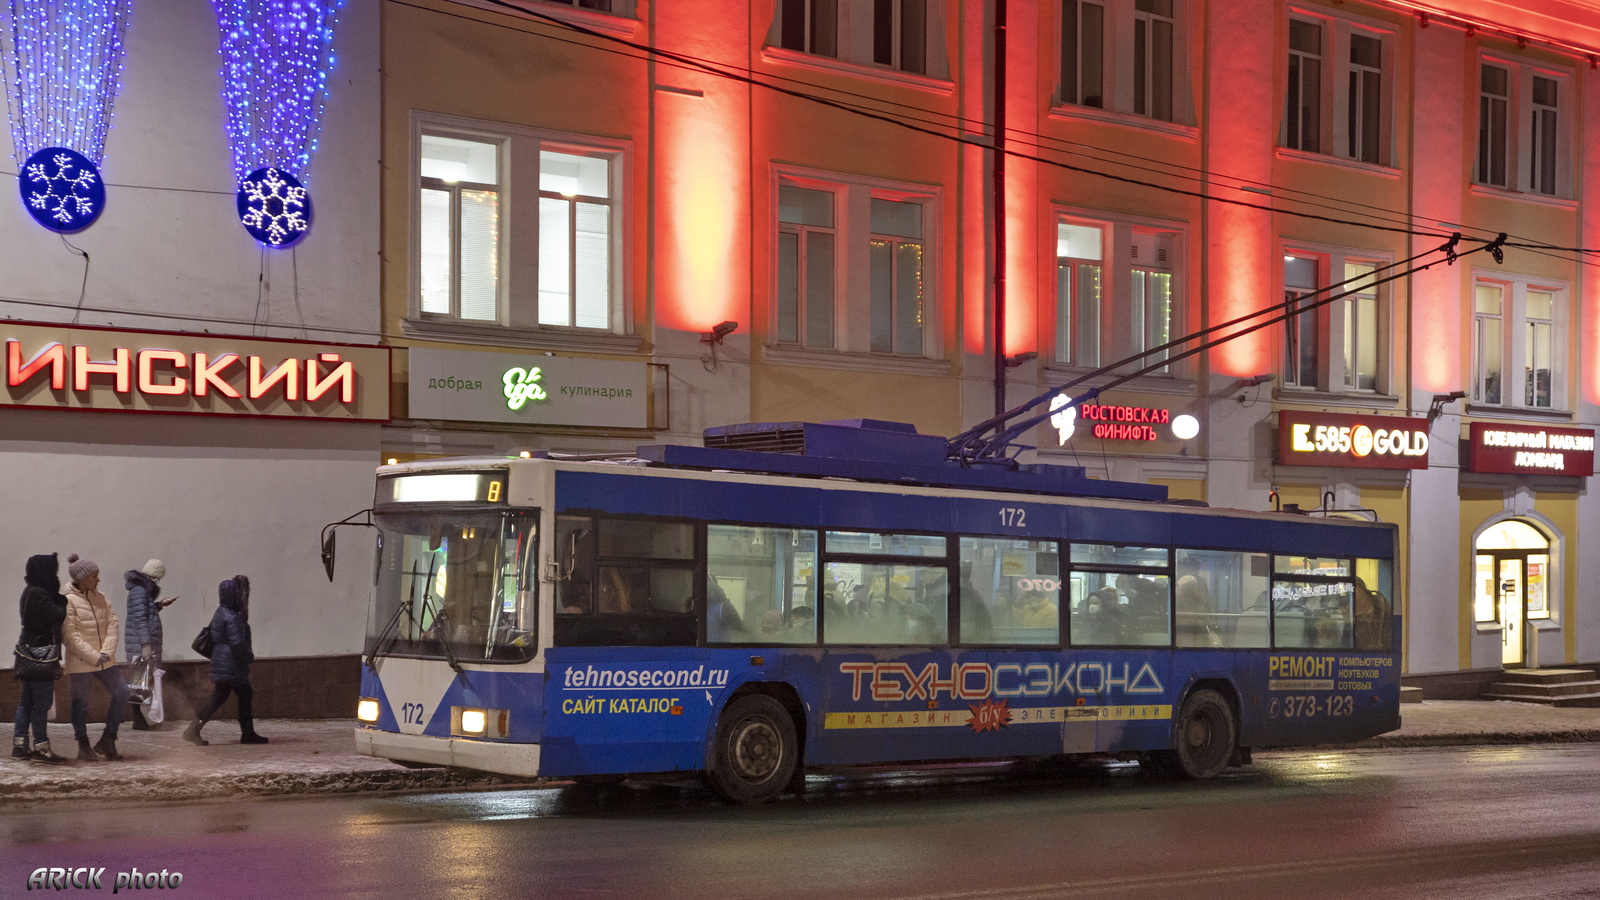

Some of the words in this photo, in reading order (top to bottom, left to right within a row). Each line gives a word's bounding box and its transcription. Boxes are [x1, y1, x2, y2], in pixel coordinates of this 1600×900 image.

[6, 337, 354, 403] ИНСКИЙ
[428, 376, 482, 391] добрая
[560, 384, 633, 400] кулинария
[1081, 404, 1169, 423] РОСТОВСКАЯ
[1094, 424, 1157, 441] ФИНИФТЬ
[1315, 425, 1350, 453] 585
[1373, 428, 1429, 456] GOLD
[1484, 430, 1547, 448] ЮВЕЛИРНЫЙ
[1549, 434, 1594, 451] МАГАЗИН
[1515, 451, 1564, 470] ЛОМБАРД
[487, 481, 501, 502] 8
[999, 507, 1026, 527] 172
[1269, 656, 1335, 677] РЕМОНТ
[1338, 657, 1393, 667] КОМПЬЮТЕРОВ
[564, 665, 729, 688] tehnosecond.ru
[840, 661, 1164, 701] ТЕХНОСЭКОНД
[1338, 669, 1379, 678] НОУТБУКОВ
[1338, 681, 1372, 690] СОТОВЫХ
[402, 702, 424, 725] 172
[562, 695, 606, 714] САЙТ
[1284, 695, 1353, 718] 373-123
[847, 712, 951, 726] МАГАЗИН
[979, 705, 1001, 727] б/у
[1021, 707, 1160, 721] ЭЛЕОНИКИ
